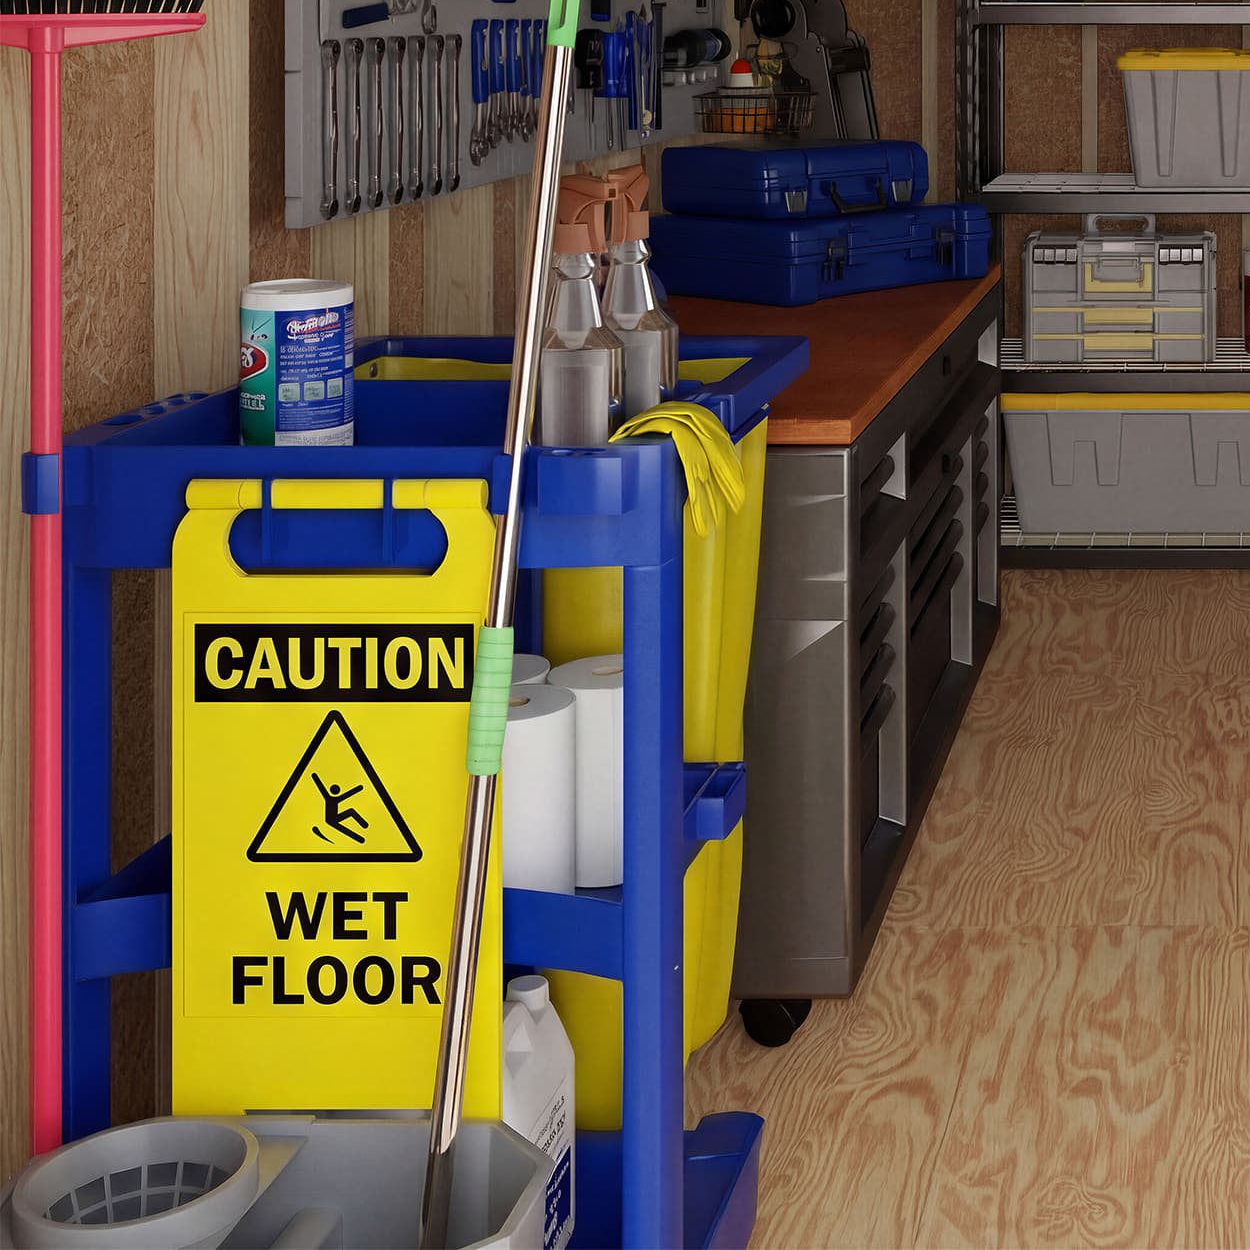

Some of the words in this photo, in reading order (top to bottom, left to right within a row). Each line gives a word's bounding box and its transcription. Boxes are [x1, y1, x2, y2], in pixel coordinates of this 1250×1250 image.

[205, 636, 464, 690] CAUTION
[265, 891, 408, 940] WET
[232, 955, 441, 1005] FLOOR
